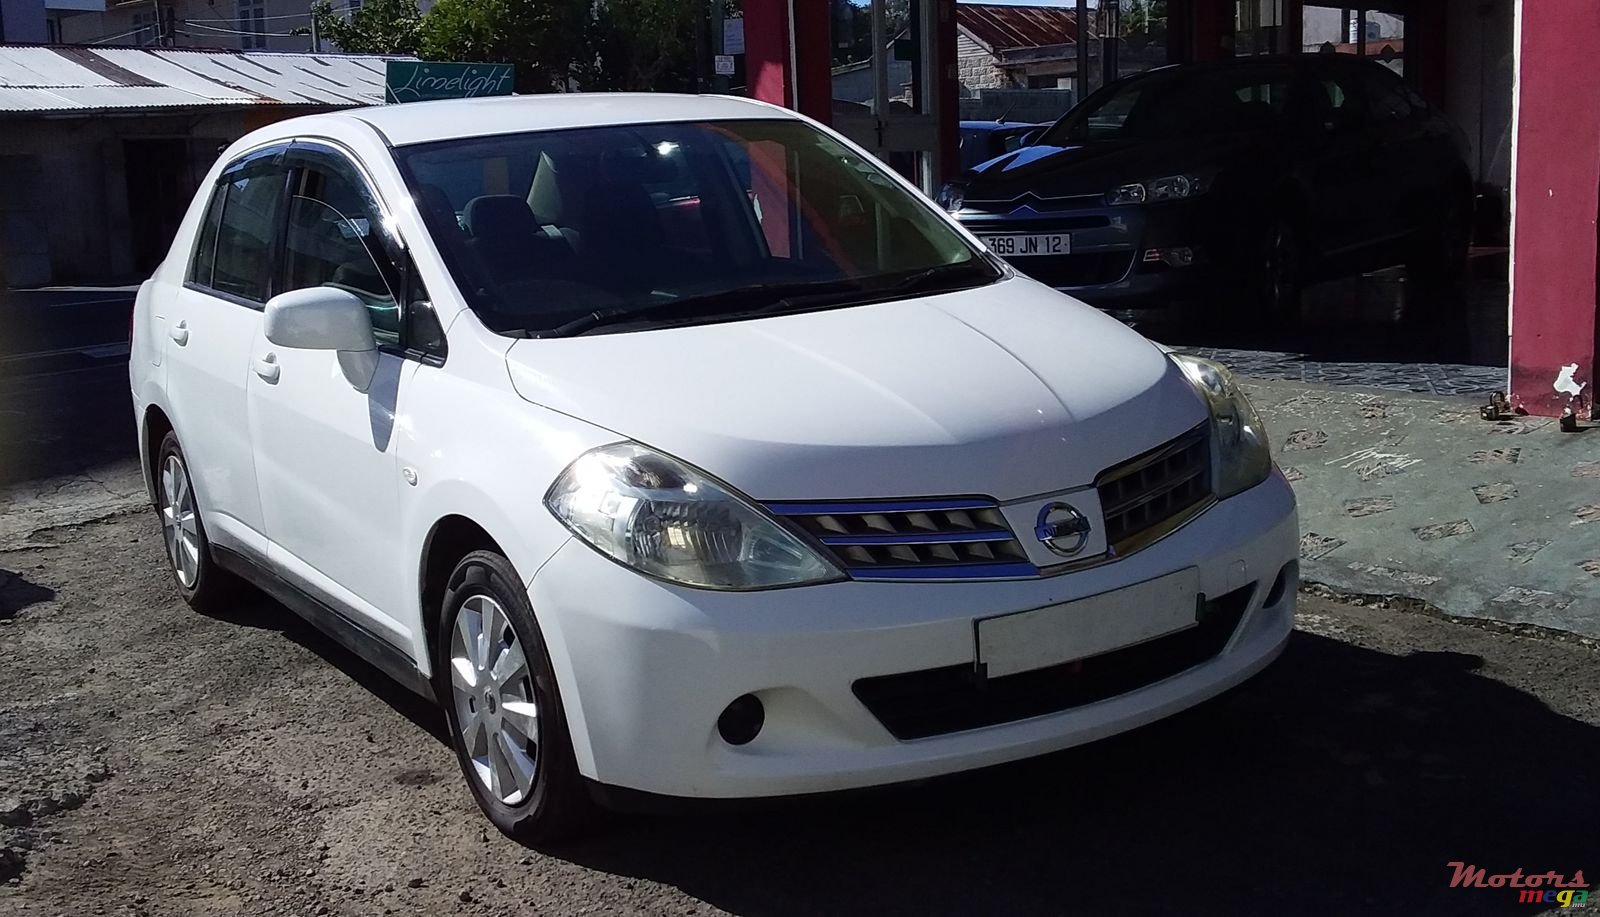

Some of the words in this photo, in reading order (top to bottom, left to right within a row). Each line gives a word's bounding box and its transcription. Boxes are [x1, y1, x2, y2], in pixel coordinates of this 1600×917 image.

[393, 65, 511, 98] Limelight
[988, 237, 1014, 254] 369
[1020, 237, 1037, 253] JN
[1045, 236, 1061, 253] 12
